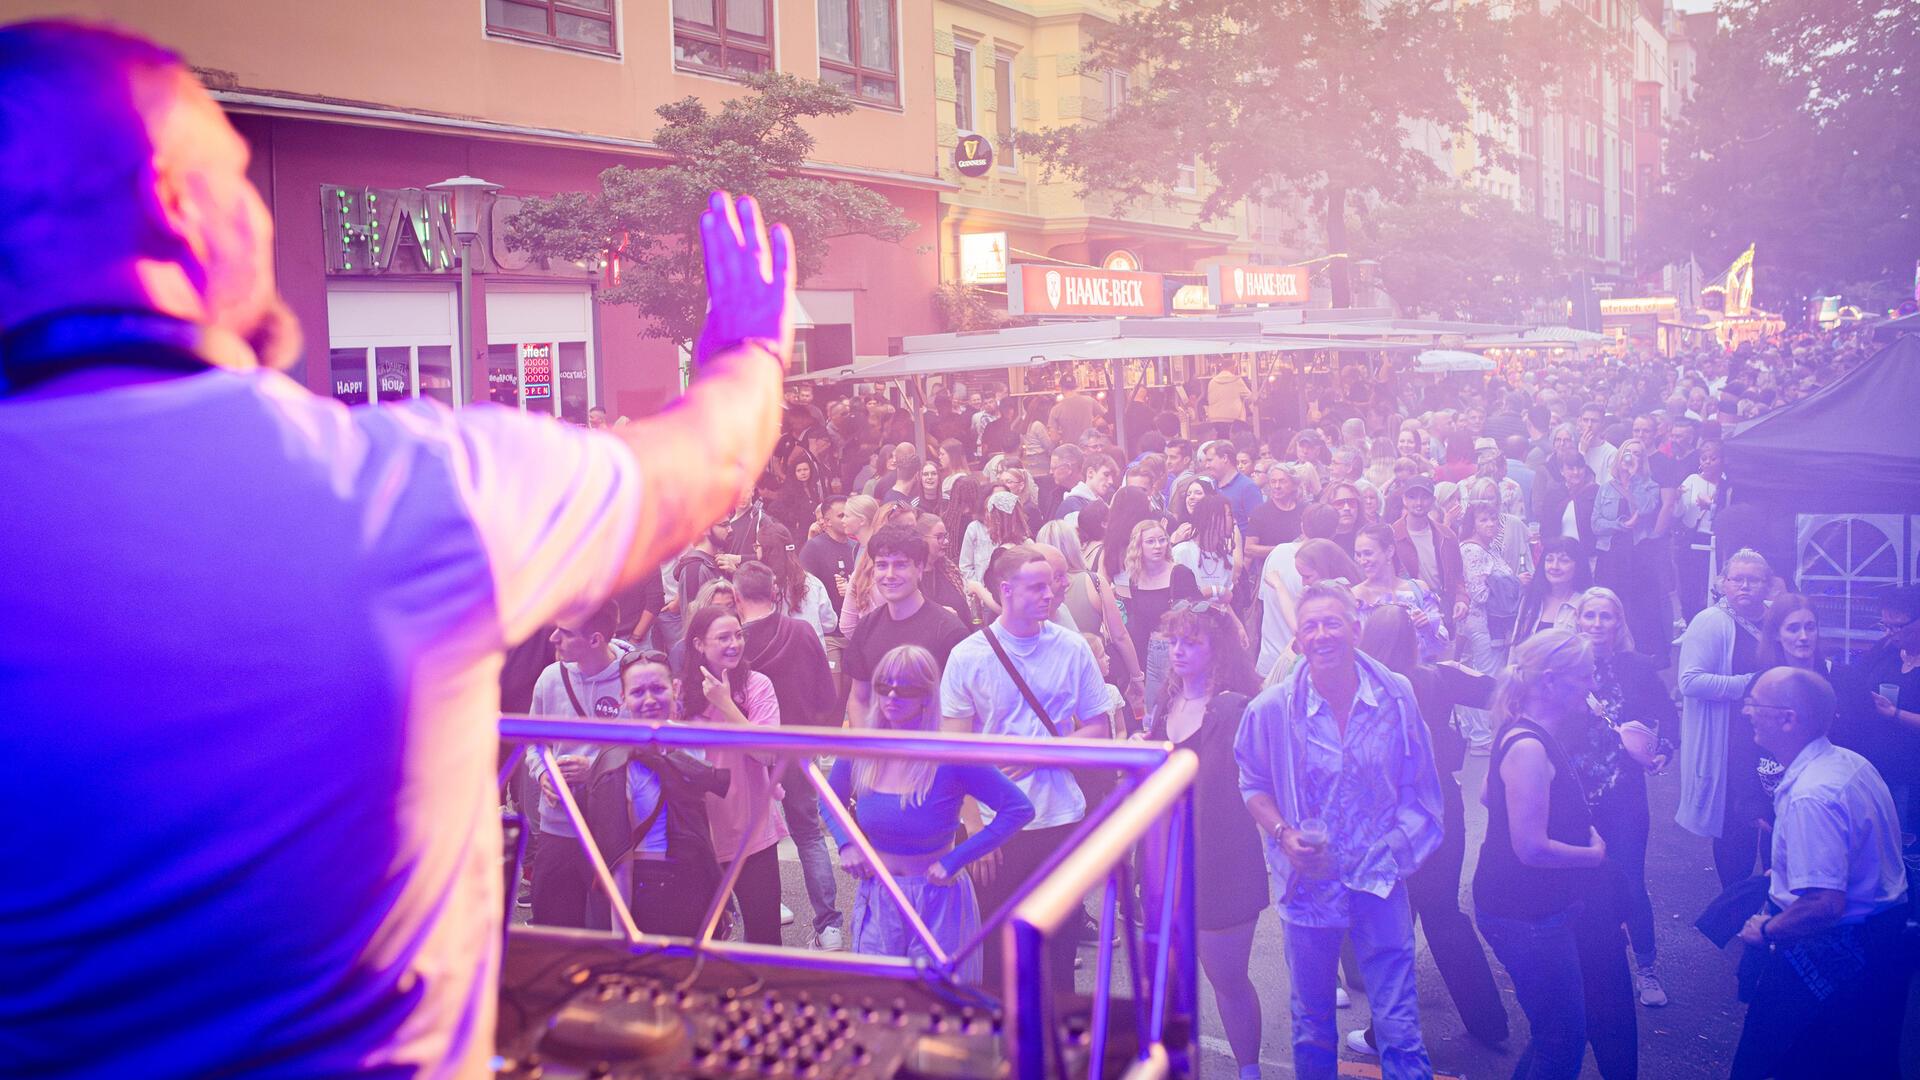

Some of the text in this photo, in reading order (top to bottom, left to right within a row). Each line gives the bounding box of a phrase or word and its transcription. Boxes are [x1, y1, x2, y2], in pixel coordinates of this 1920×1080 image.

[1065, 276, 1145, 307] HAAKE-BECK
[1246, 272, 1298, 296] HAAKE-BECK
[336, 378, 405, 395] HAPPY HOUR
[524, 386, 549, 396] OPEN
[595, 703, 618, 714] NASA
